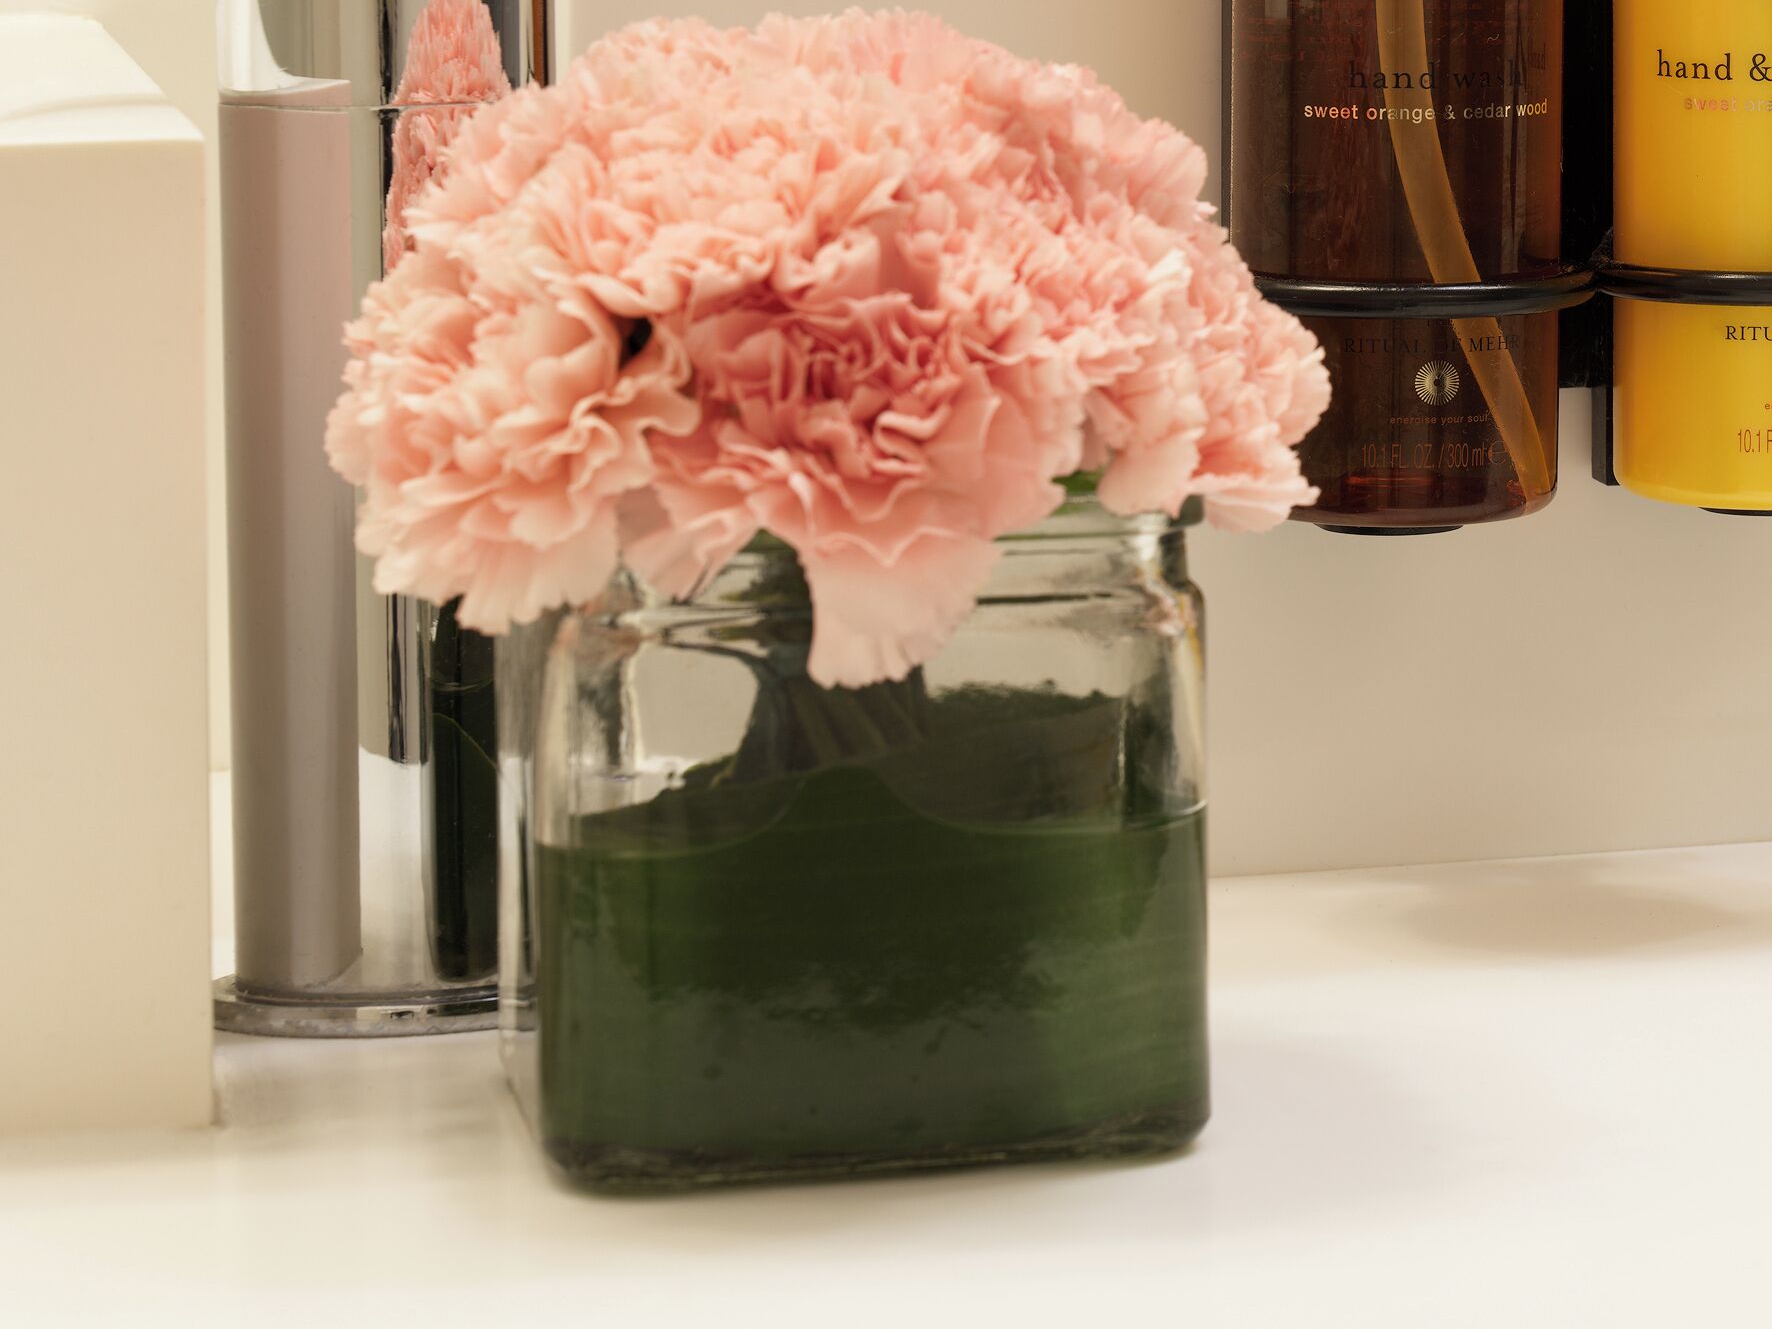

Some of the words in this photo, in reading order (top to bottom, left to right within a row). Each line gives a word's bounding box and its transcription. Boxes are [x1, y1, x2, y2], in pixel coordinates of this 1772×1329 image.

[1349, 59, 1436, 90] hand
[1656, 49, 1734, 81] hand
[1303, 104, 1358, 118] sweet
[1366, 108, 1436, 124] orange
[1444, 105, 1456, 121] &
[1463, 102, 1510, 120] cedar
[1516, 98, 1548, 117] wood
[1684, 96, 1737, 112] sweet
[1469, 334, 1521, 353] MEHR
[1440, 415, 1464, 426] your
[1738, 428, 1761, 453] 10.1
[1362, 443, 1387, 469] 10.1
[1448, 443, 1469, 468] 300
